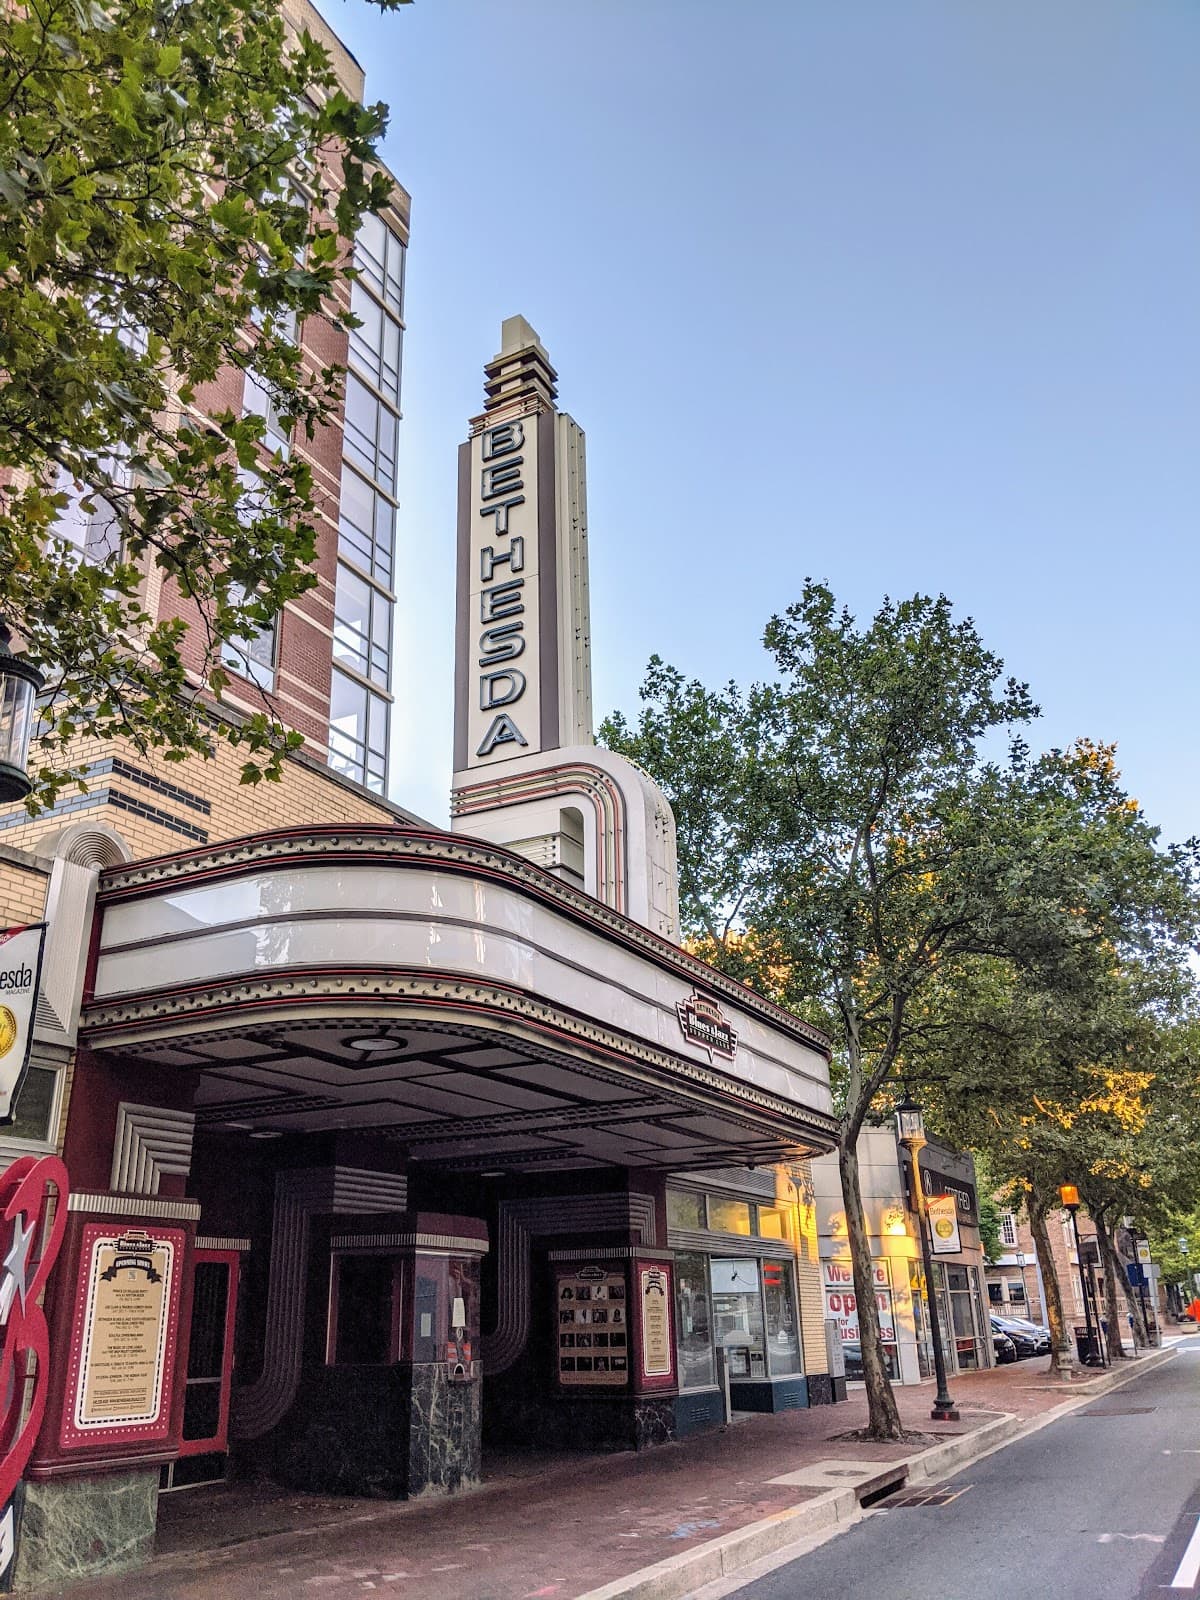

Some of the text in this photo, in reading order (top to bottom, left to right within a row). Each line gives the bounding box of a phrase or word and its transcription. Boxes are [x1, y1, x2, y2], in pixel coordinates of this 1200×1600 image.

[476, 419, 529, 757] BETHESDA
[689, 1012, 710, 1033] Blues
[827, 1265, 851, 1282] We
[830, 1293, 887, 1317] opn
[841, 1325, 893, 1339] usiss
